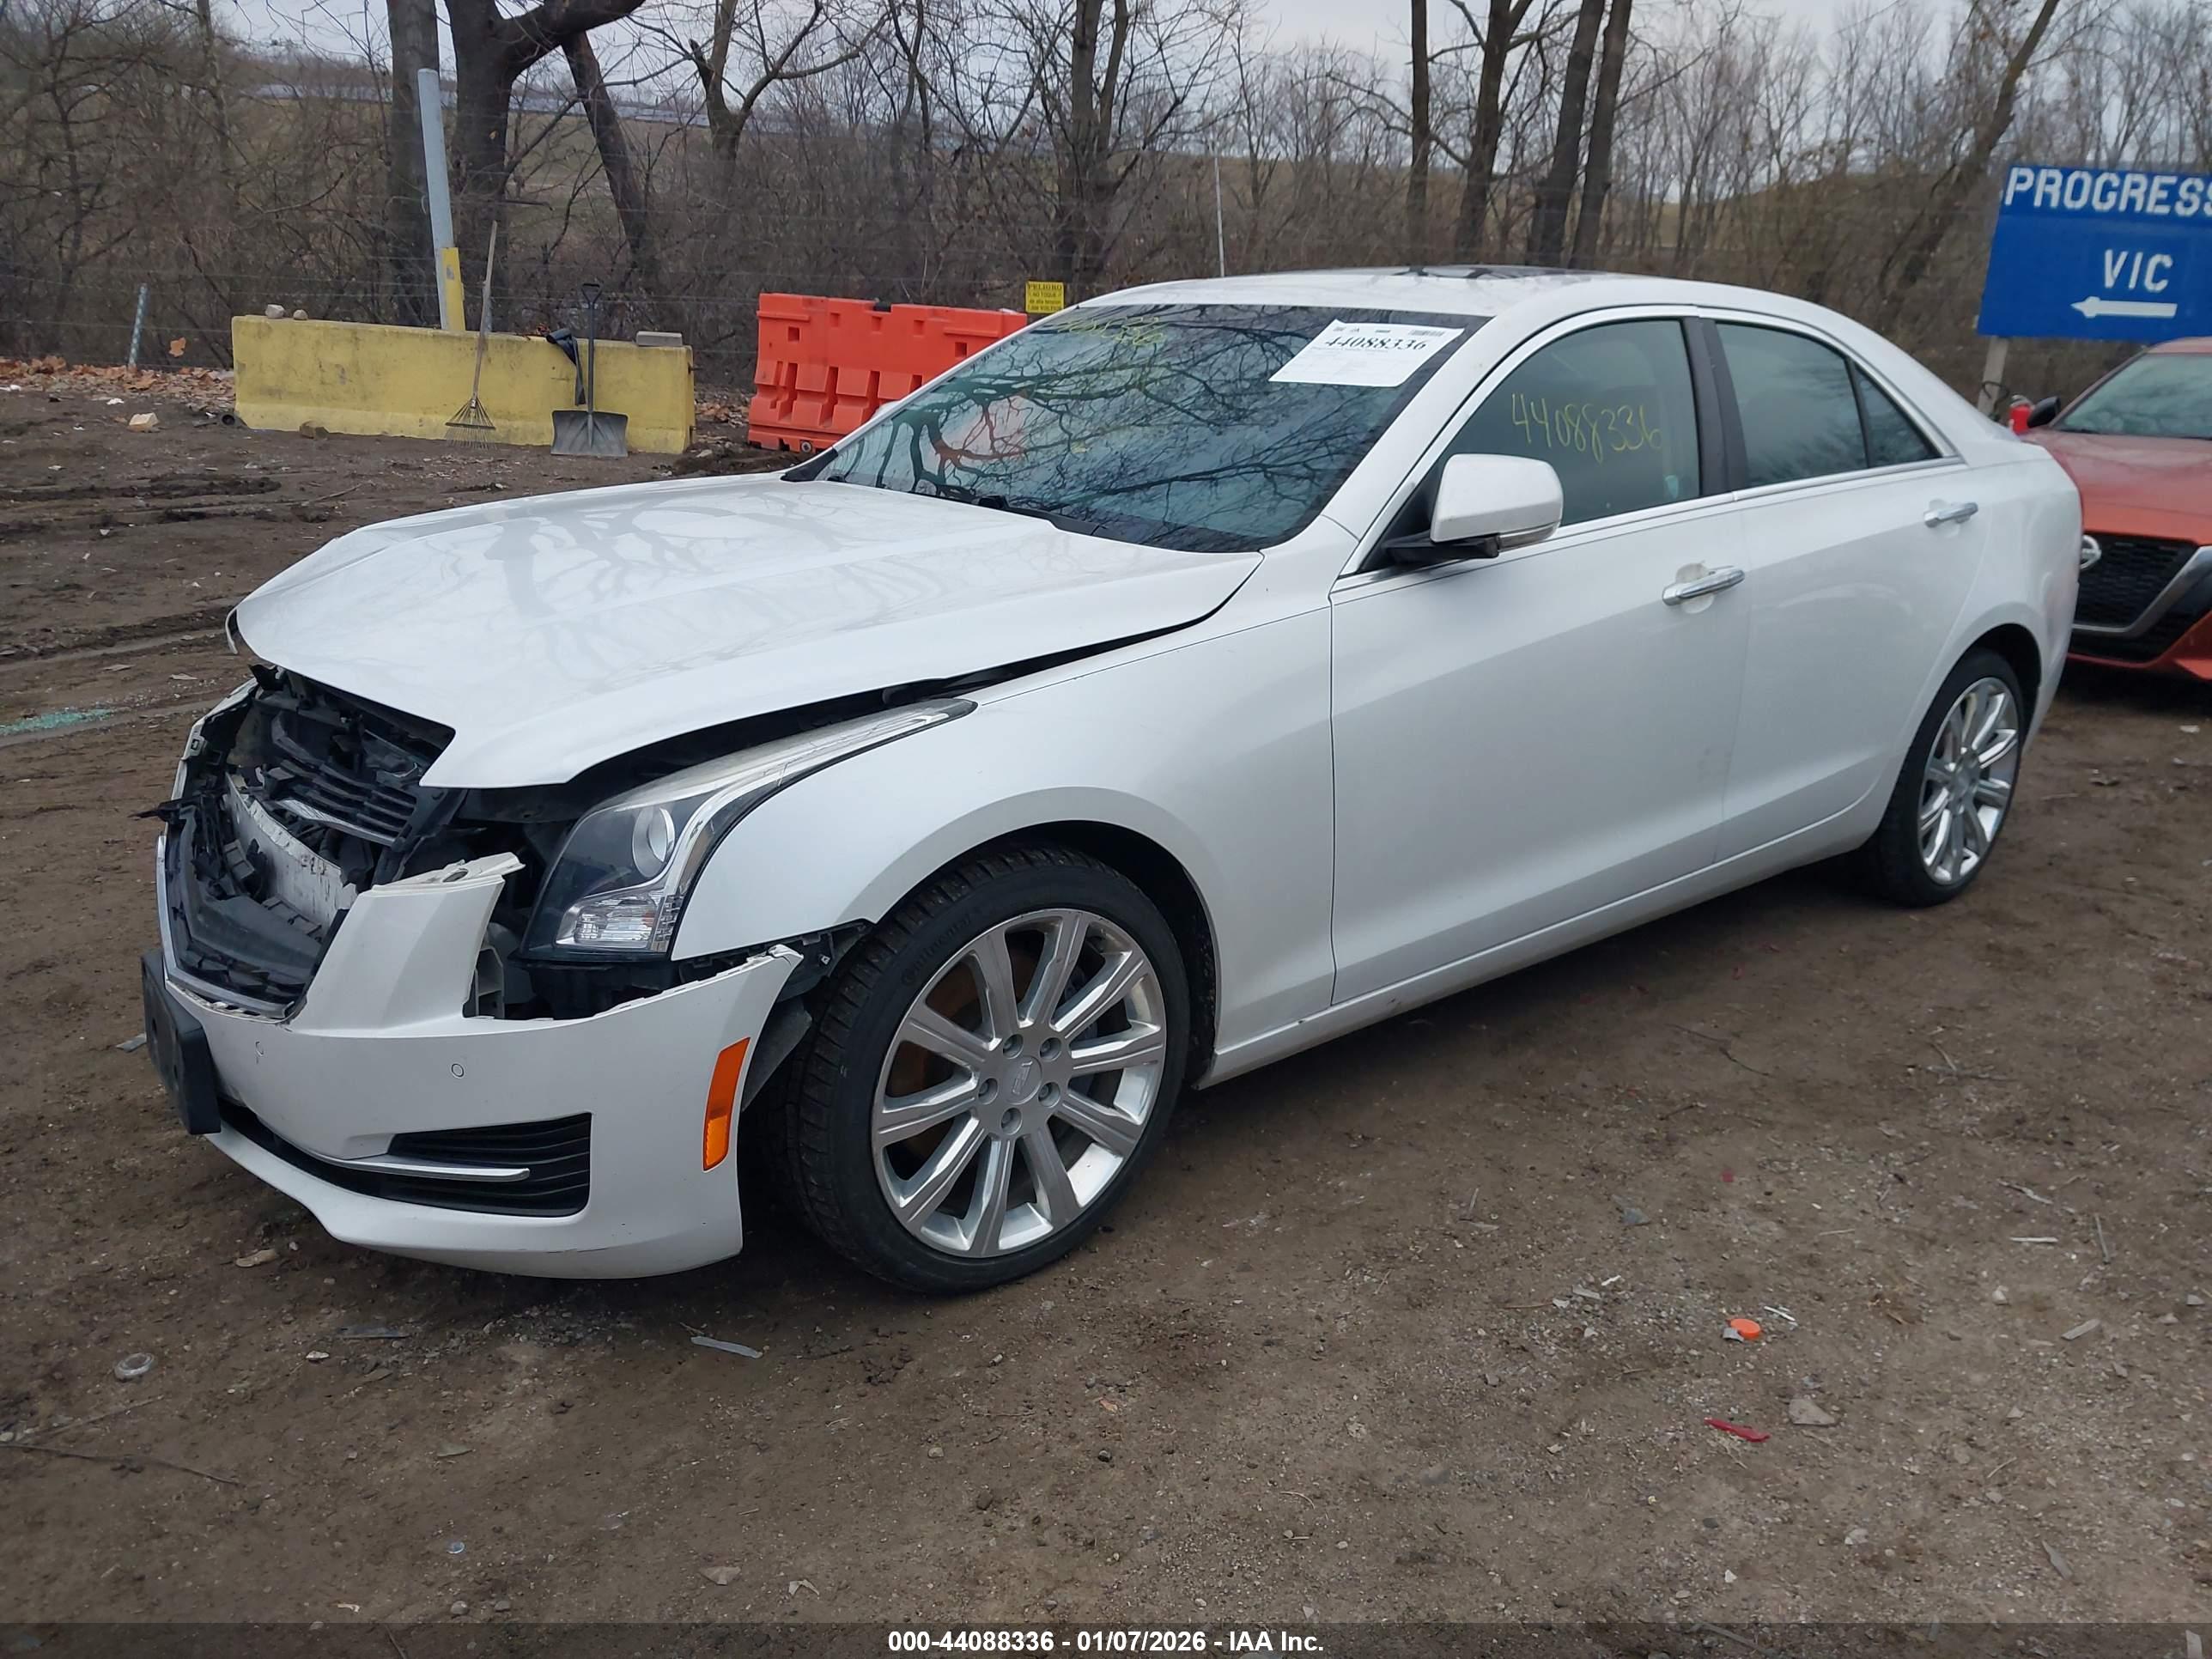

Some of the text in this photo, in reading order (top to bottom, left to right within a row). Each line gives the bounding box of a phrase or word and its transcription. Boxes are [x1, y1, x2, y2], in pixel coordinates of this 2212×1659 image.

[2004, 167, 2212, 216] PROGRES
[2105, 249, 2173, 293] VIC
[1325, 336, 1427, 351] 44088336
[1512, 393, 1662, 464] 44088336
